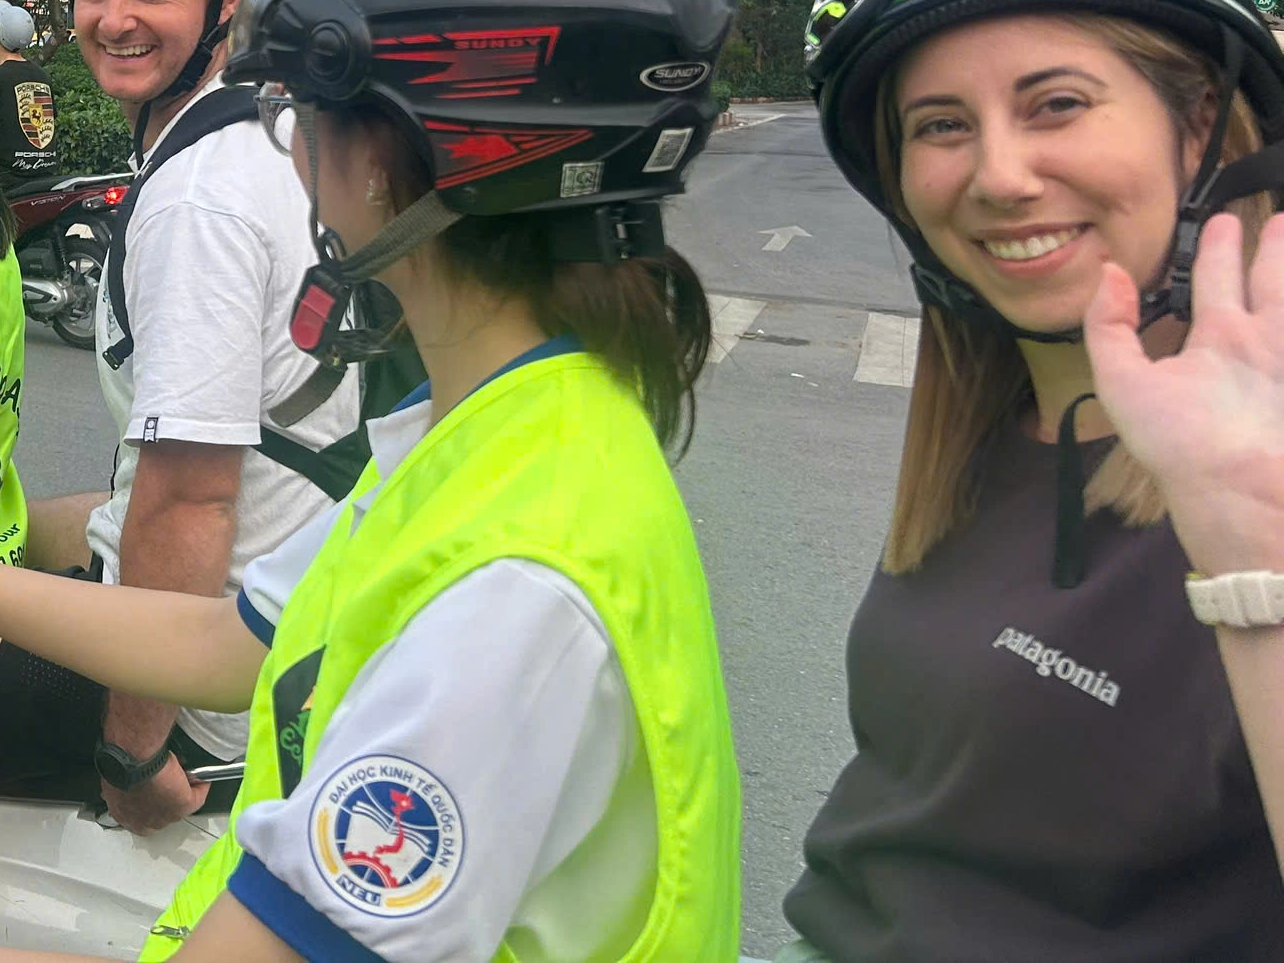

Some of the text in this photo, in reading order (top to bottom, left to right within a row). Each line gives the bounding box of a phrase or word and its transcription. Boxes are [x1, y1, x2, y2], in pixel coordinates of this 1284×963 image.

[454, 37, 542, 51] SUNDY
[992, 627, 1121, 707] patagonia
[328, 765, 457, 869] ĐẠI HỌC KINH TẾ QUỐC DÂN
[336, 875, 382, 906] NEU
